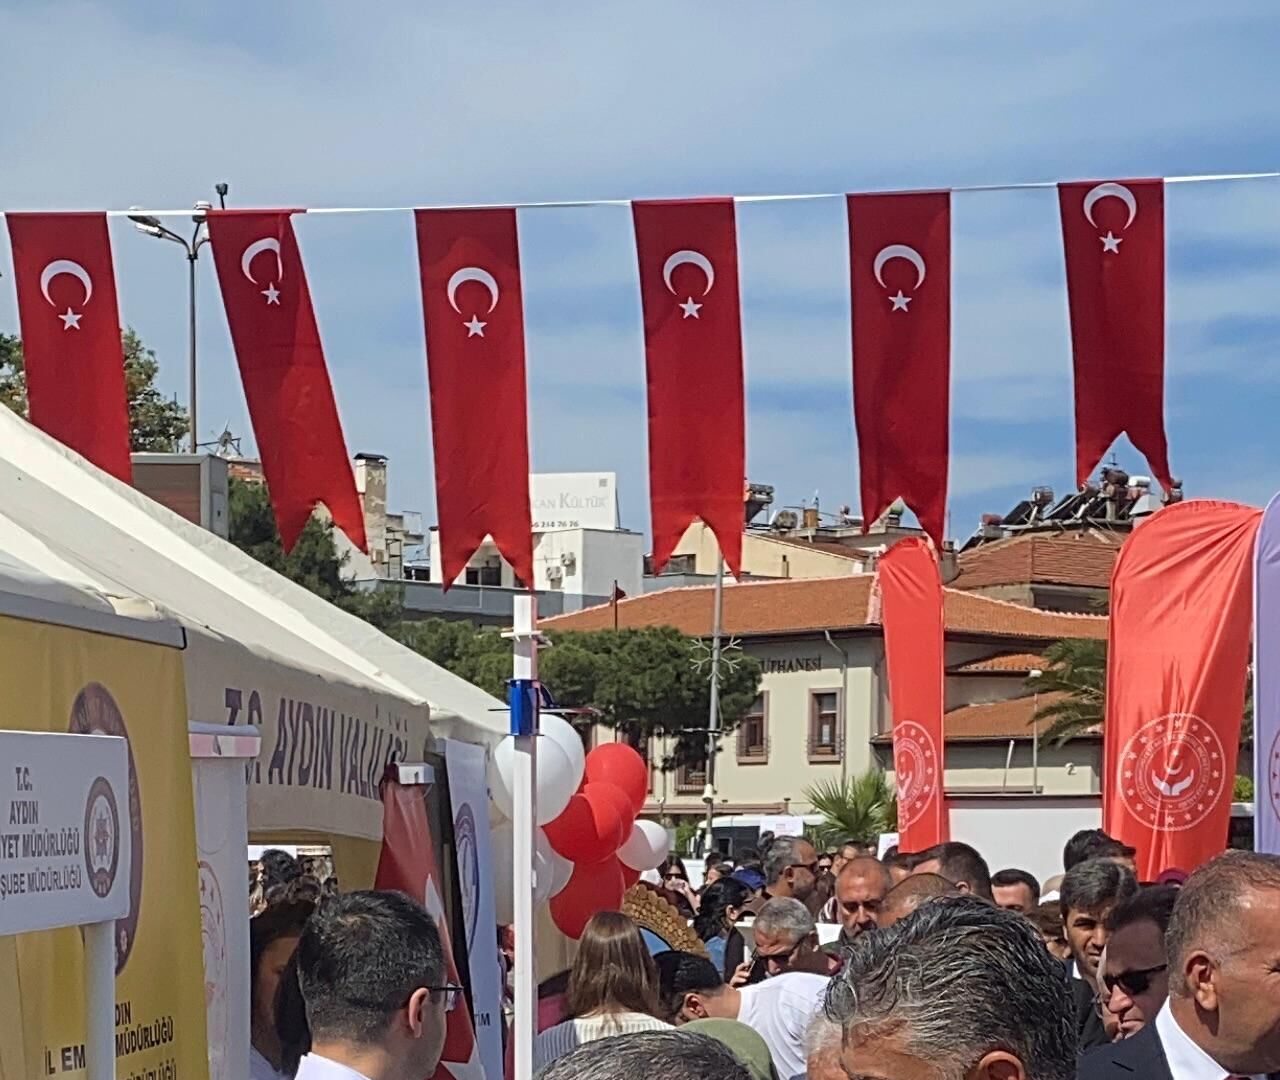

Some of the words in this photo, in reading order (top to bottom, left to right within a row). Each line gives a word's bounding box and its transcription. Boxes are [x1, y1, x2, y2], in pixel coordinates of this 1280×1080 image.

[268, 698, 336, 790] AYDIN
[15, 766, 33, 791] T.C.
[9, 800, 39, 825] AYDIN
[22, 827, 80, 858] MÜDÜRLÜĞÜ
[0, 873, 26, 900] ŞUBE
[27, 865, 82, 893] MÜDÜRLÜĞÜ
[44, 1045, 56, 1076] İL
